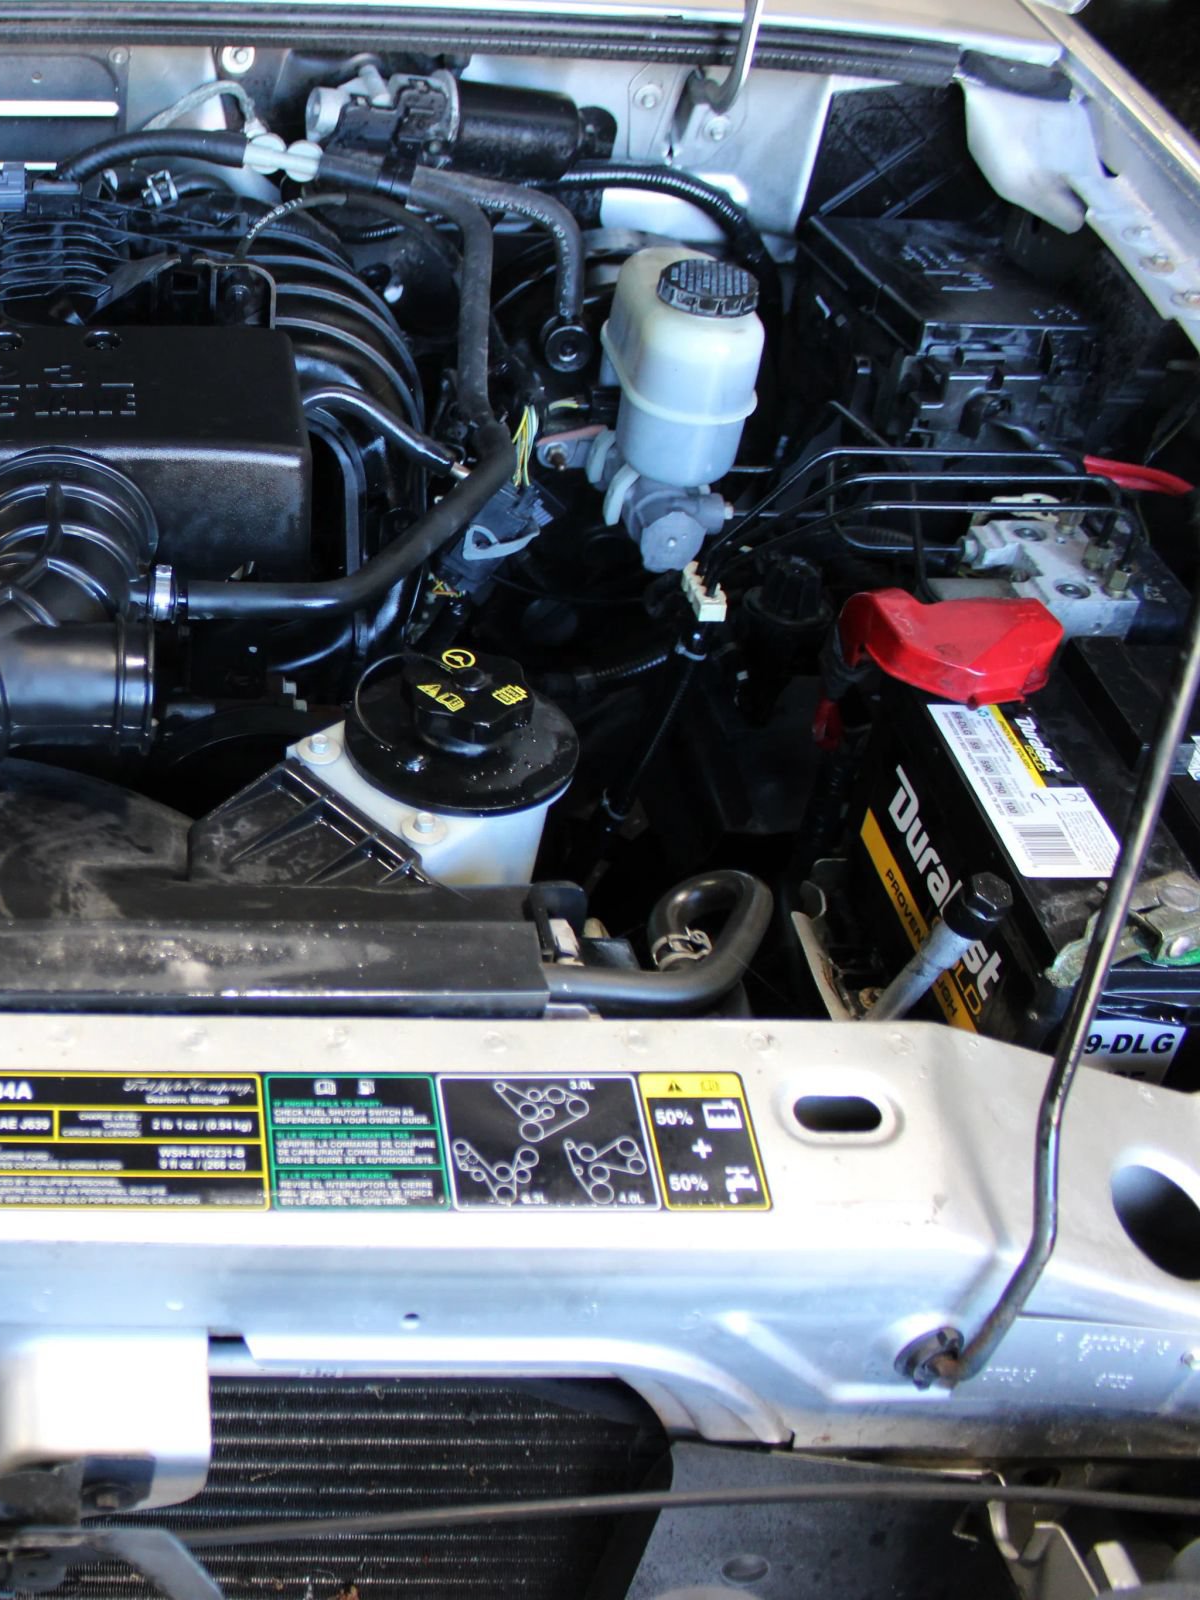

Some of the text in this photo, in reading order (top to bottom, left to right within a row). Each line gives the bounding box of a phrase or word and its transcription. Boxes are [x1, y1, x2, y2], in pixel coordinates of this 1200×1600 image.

[1014, 716, 1064, 773] Duralast
[1024, 745, 1046, 772] GOLD
[970, 741, 1018, 814] 59 590 750 100
[888, 764, 1002, 1001] Duralst
[885, 868, 925, 946] PROVEN
[1084, 1033, 1176, 1054] 9-DLG
[123, 1080, 152, 1093] Ford
[146, 1081, 190, 1096] Motor
[569, 1080, 595, 1091] 3.0L
[145, 1095, 230, 1106] Dearborn, Michigan
[274, 1108, 414, 1117] CHECK FUEL SHUTOFF SWITCH AS
[655, 1108, 694, 1126] 50%
[19, 1117, 50, 1131] J639
[152, 1118, 160, 1131] 2
[161, 1118, 174, 1131] lb
[183, 1118, 198, 1132] oz
[205, 1118, 232, 1132] (0.94
[233, 1119, 252, 1133] kg)
[274, 1116, 432, 1125] REFERENCED IN YOUR OWNER GUIDE.
[316, 1140, 328, 1149] LA
[329, 1140, 379, 1149] COMMANDE
[380, 1140, 393, 1149] DE
[394, 1140, 436, 1149] COUPURE
[158, 1147, 246, 1159] WSH-M1C231-B
[276, 1148, 290, 1157] DE
[346, 1148, 379, 1157] COMME
[160, 1159, 168, 1170] 9
[169, 1159, 178, 1170] fl
[179, 1159, 194, 1171] oz
[201, 1159, 227, 1171] (266
[228, 1160, 248, 1171] cc)
[278, 1156, 302, 1165] DANS
[303, 1156, 315, 1165] LE
[316, 1156, 343, 1165] GUIDE
[344, 1156, 357, 1165] DE
[280, 1180, 434, 1189] REVISE EL INTERRUPTOR DE CIERRE
[670, 1175, 708, 1192] 50%
[362, 1188, 389, 1197] COMO
[390, 1188, 402, 1197] SE
[403, 1188, 434, 1197] INDICA
[619, 1192, 644, 1205] 4.0L
[280, 1197, 294, 1206] EN
[295, 1197, 307, 1206] LA
[331, 1197, 348, 1206] DEL
